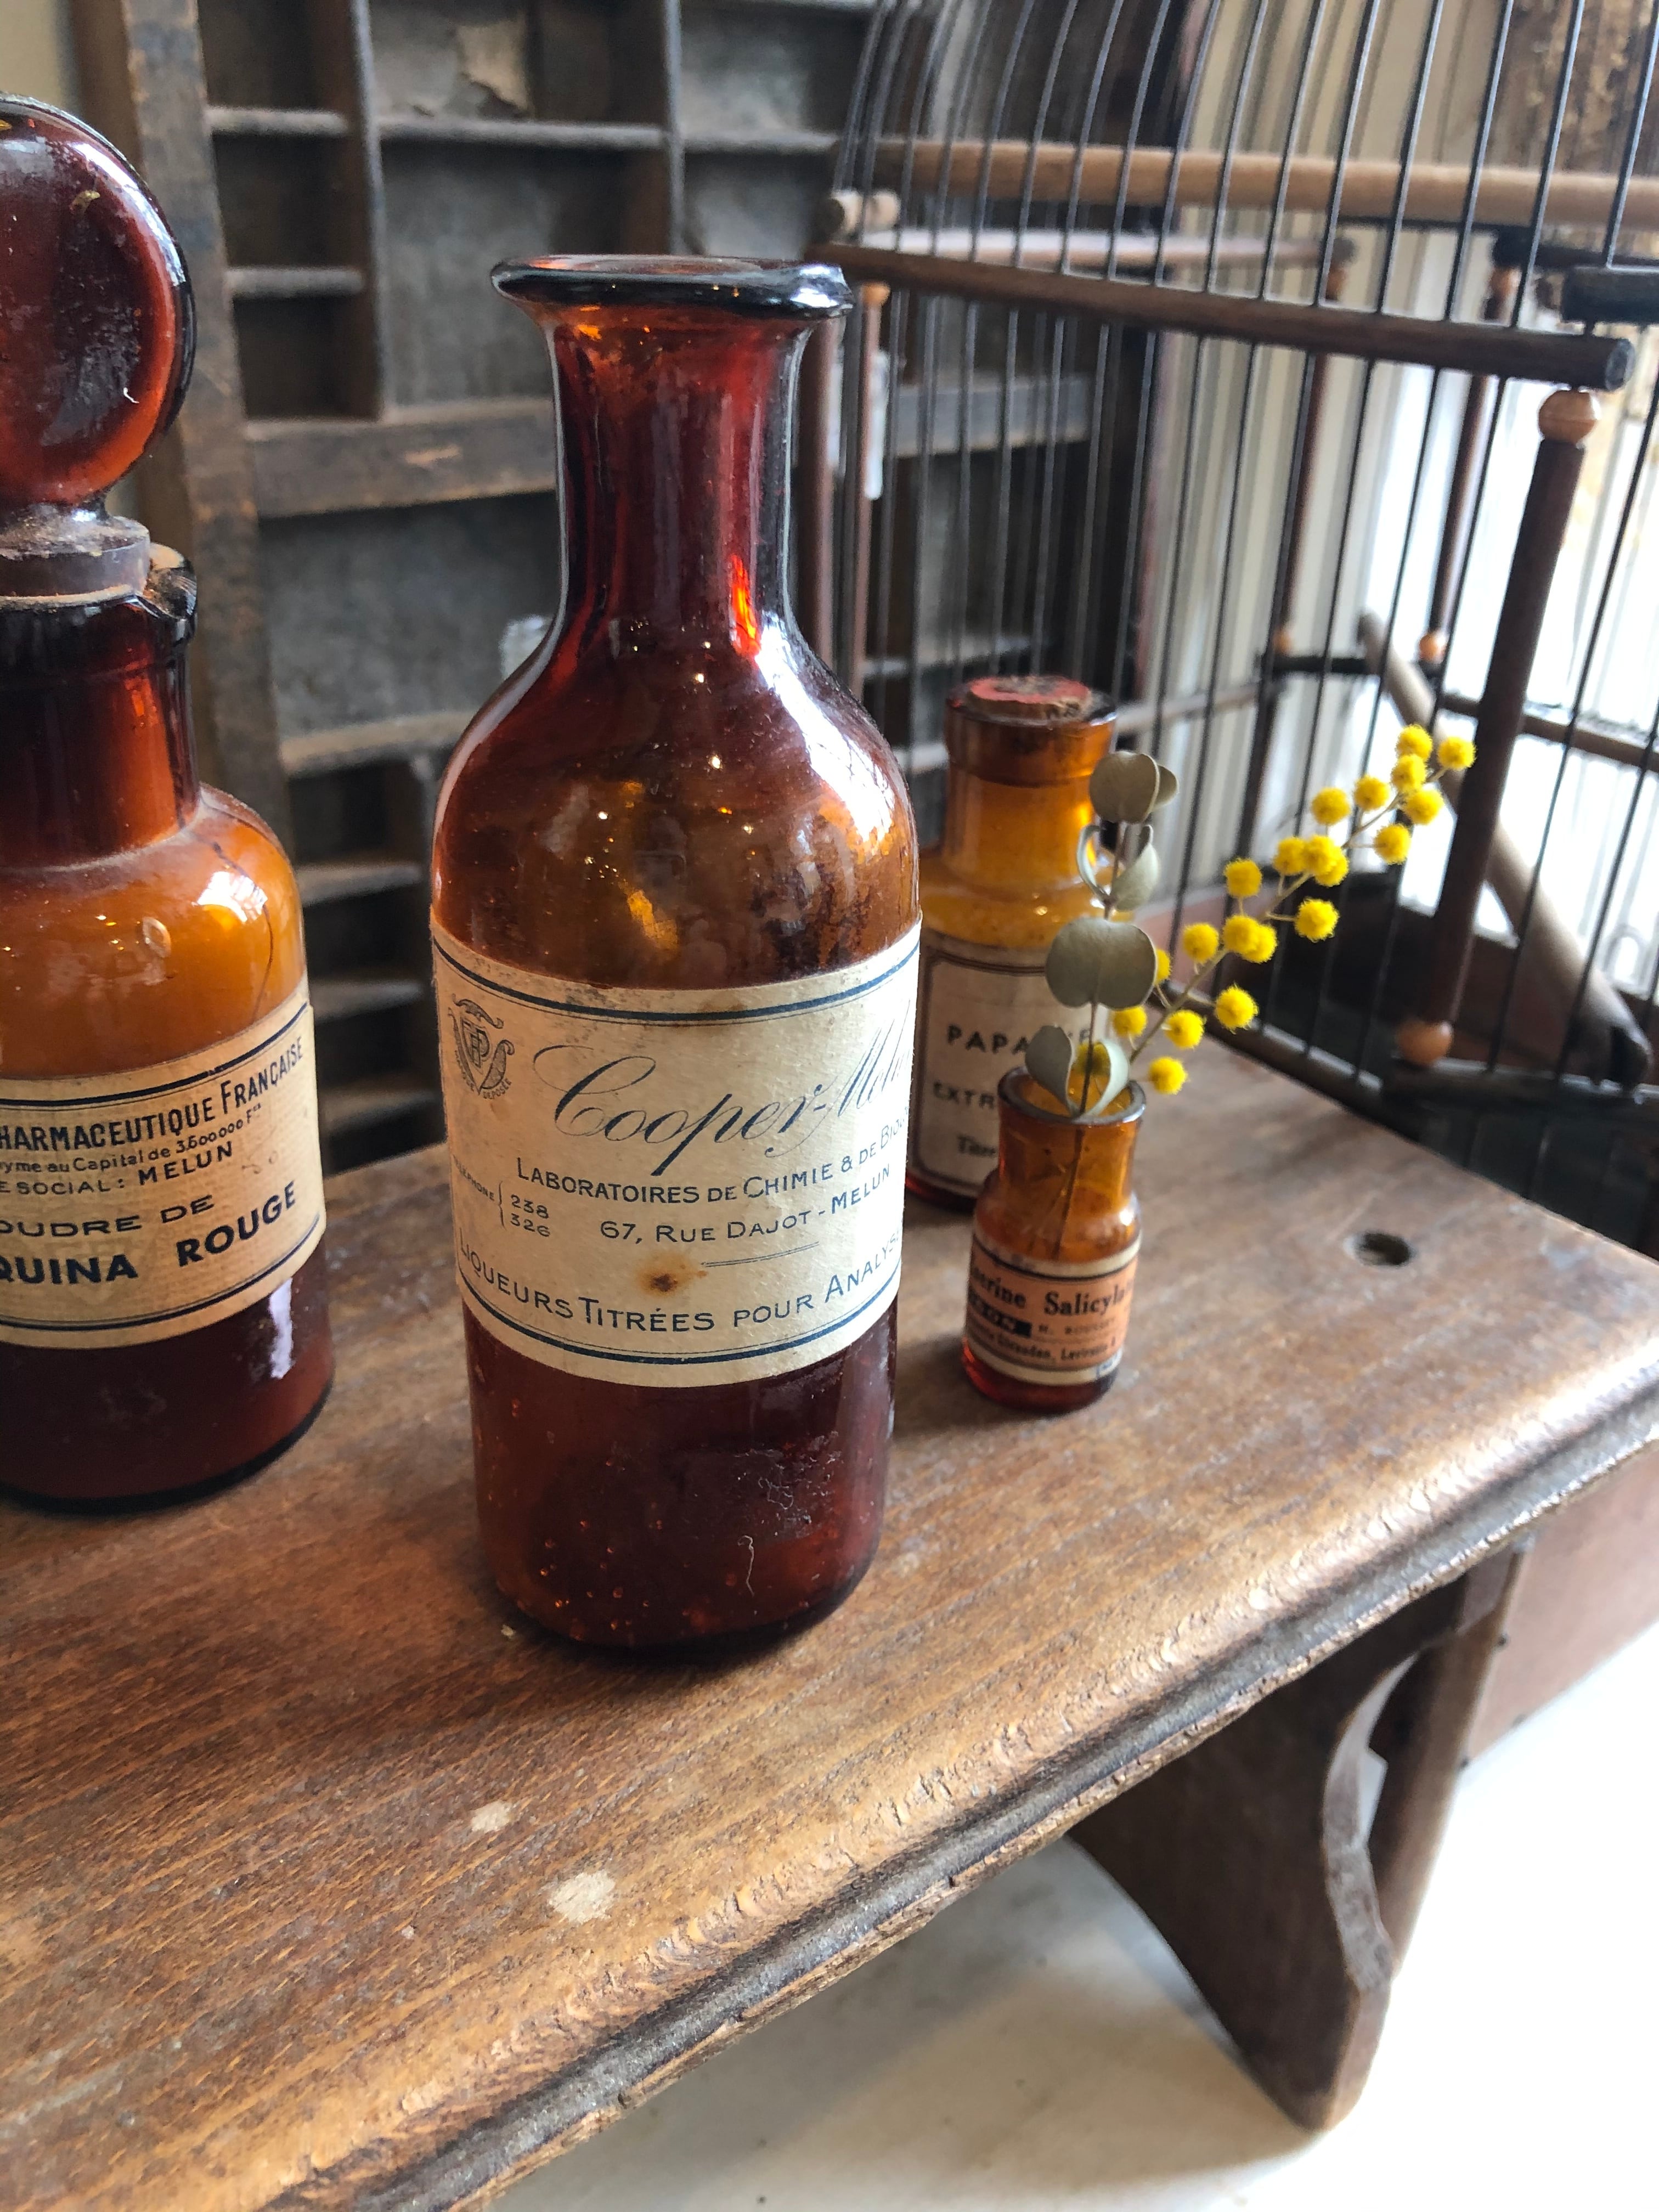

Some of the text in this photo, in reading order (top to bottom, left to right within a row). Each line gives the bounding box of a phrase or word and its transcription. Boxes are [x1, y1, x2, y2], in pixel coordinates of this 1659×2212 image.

[221, 1036, 303, 1114] FRANÇAISE
[48, 1163, 70, 1172] au
[73, 1150, 144, 1171] Capital
[148, 1147, 171, 1161] de
[138, 1141, 232, 1186] MELUN
[517, 1157, 700, 1204] LABORATOIRES
[708, 1186, 737, 1203] DE
[743, 1163, 833, 1199] CHIMIE
[841, 1155, 853, 1173] &
[859, 1142, 876, 1166] DE
[161, 1195, 215, 1223] DE
[176, 1180, 296, 1267] ROUGE
[510, 1194, 549, 1218] 238
[510, 1213, 550, 1237] 326
[601, 1221, 643, 1244] 67,
[657, 1224, 716, 1243] RUE
[727, 1210, 811, 1240] DAJOT
[832, 1163, 889, 1214] MELUN
[460, 1227, 573, 1319] LIQUEURS
[578, 1296, 715, 1332] TITRÉES
[733, 1294, 814, 1328] POUR
